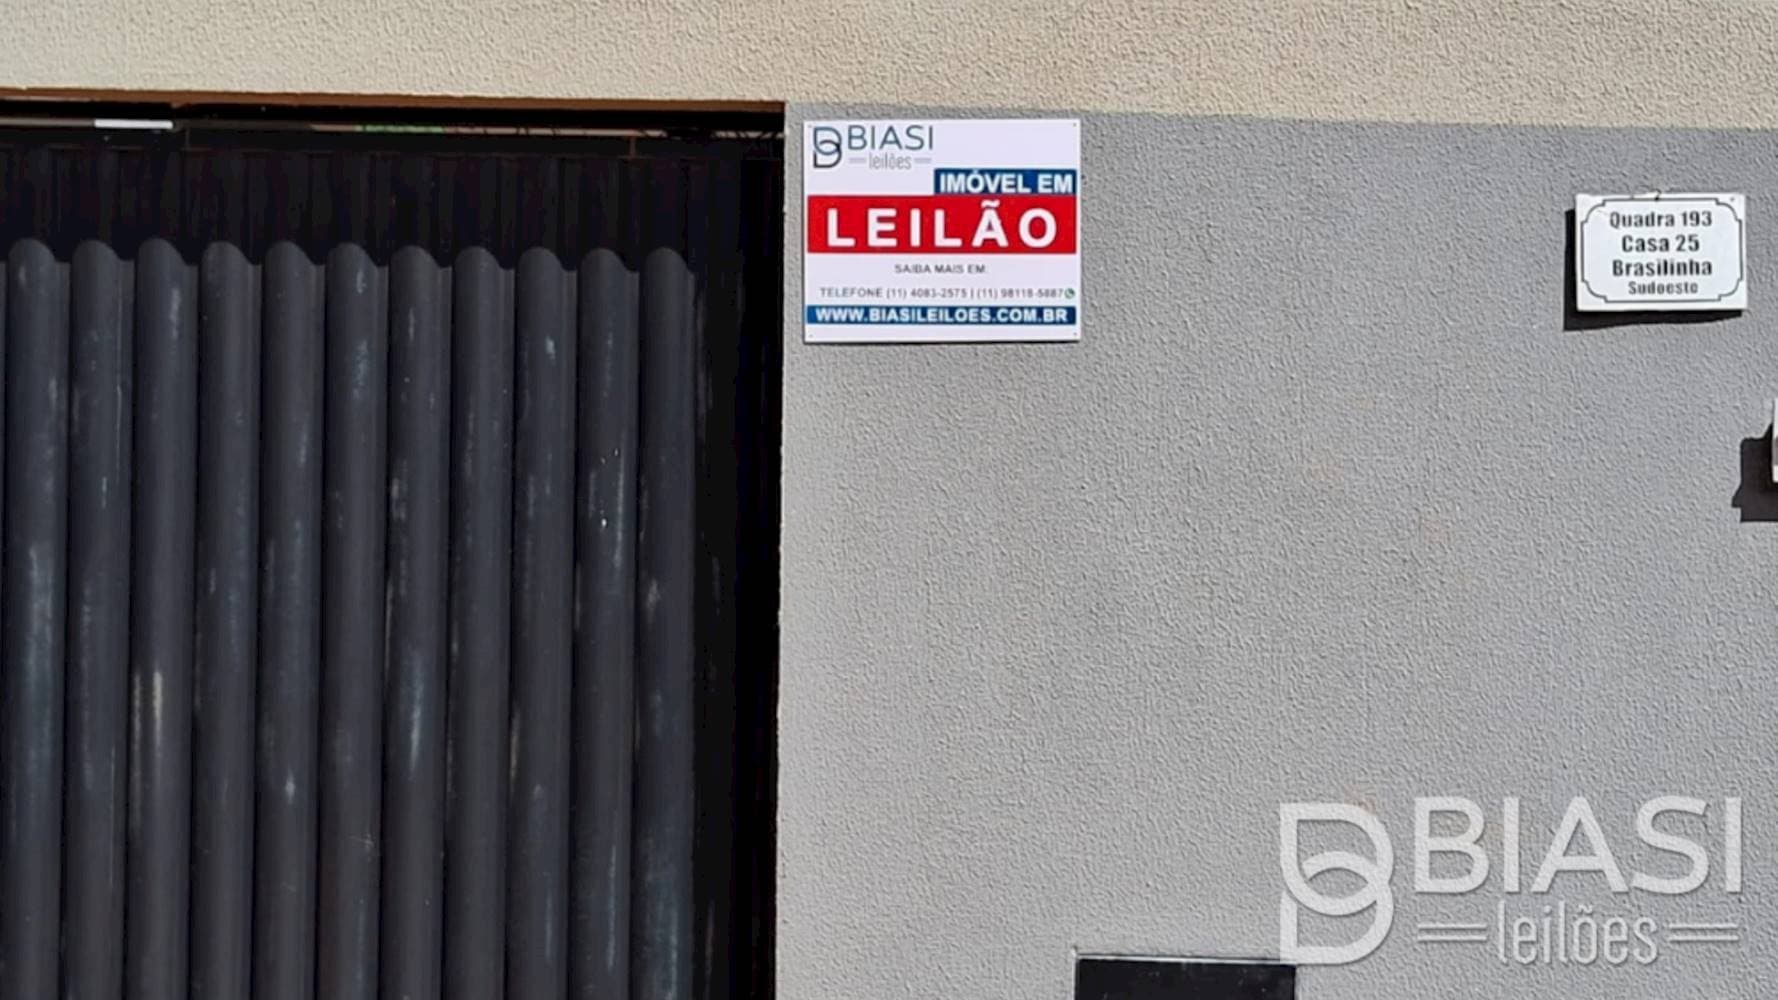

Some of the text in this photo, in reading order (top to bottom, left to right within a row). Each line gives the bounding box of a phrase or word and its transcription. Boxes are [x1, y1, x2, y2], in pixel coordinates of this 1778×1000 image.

[847, 125, 934, 150] BIASI
[868, 151, 912, 170] leilões
[939, 171, 1073, 194] IMÓVEL EM
[827, 200, 1057, 248] LEILÃO
[1609, 210, 1713, 229] Quadra 193
[1621, 234, 1700, 253] Casa 25
[894, 264, 932, 274] SAIBA
[934, 264, 964, 274] MAIS
[1612, 259, 1713, 277] Brasilinha
[820, 287, 883, 298] TELEFONE
[886, 287, 907, 299] (11)
[977, 287, 998, 299] (11)
[1628, 281, 1698, 295] Sudoeste
[815, 307, 1068, 323] WWW.BIASILEILOES.COM.BR
